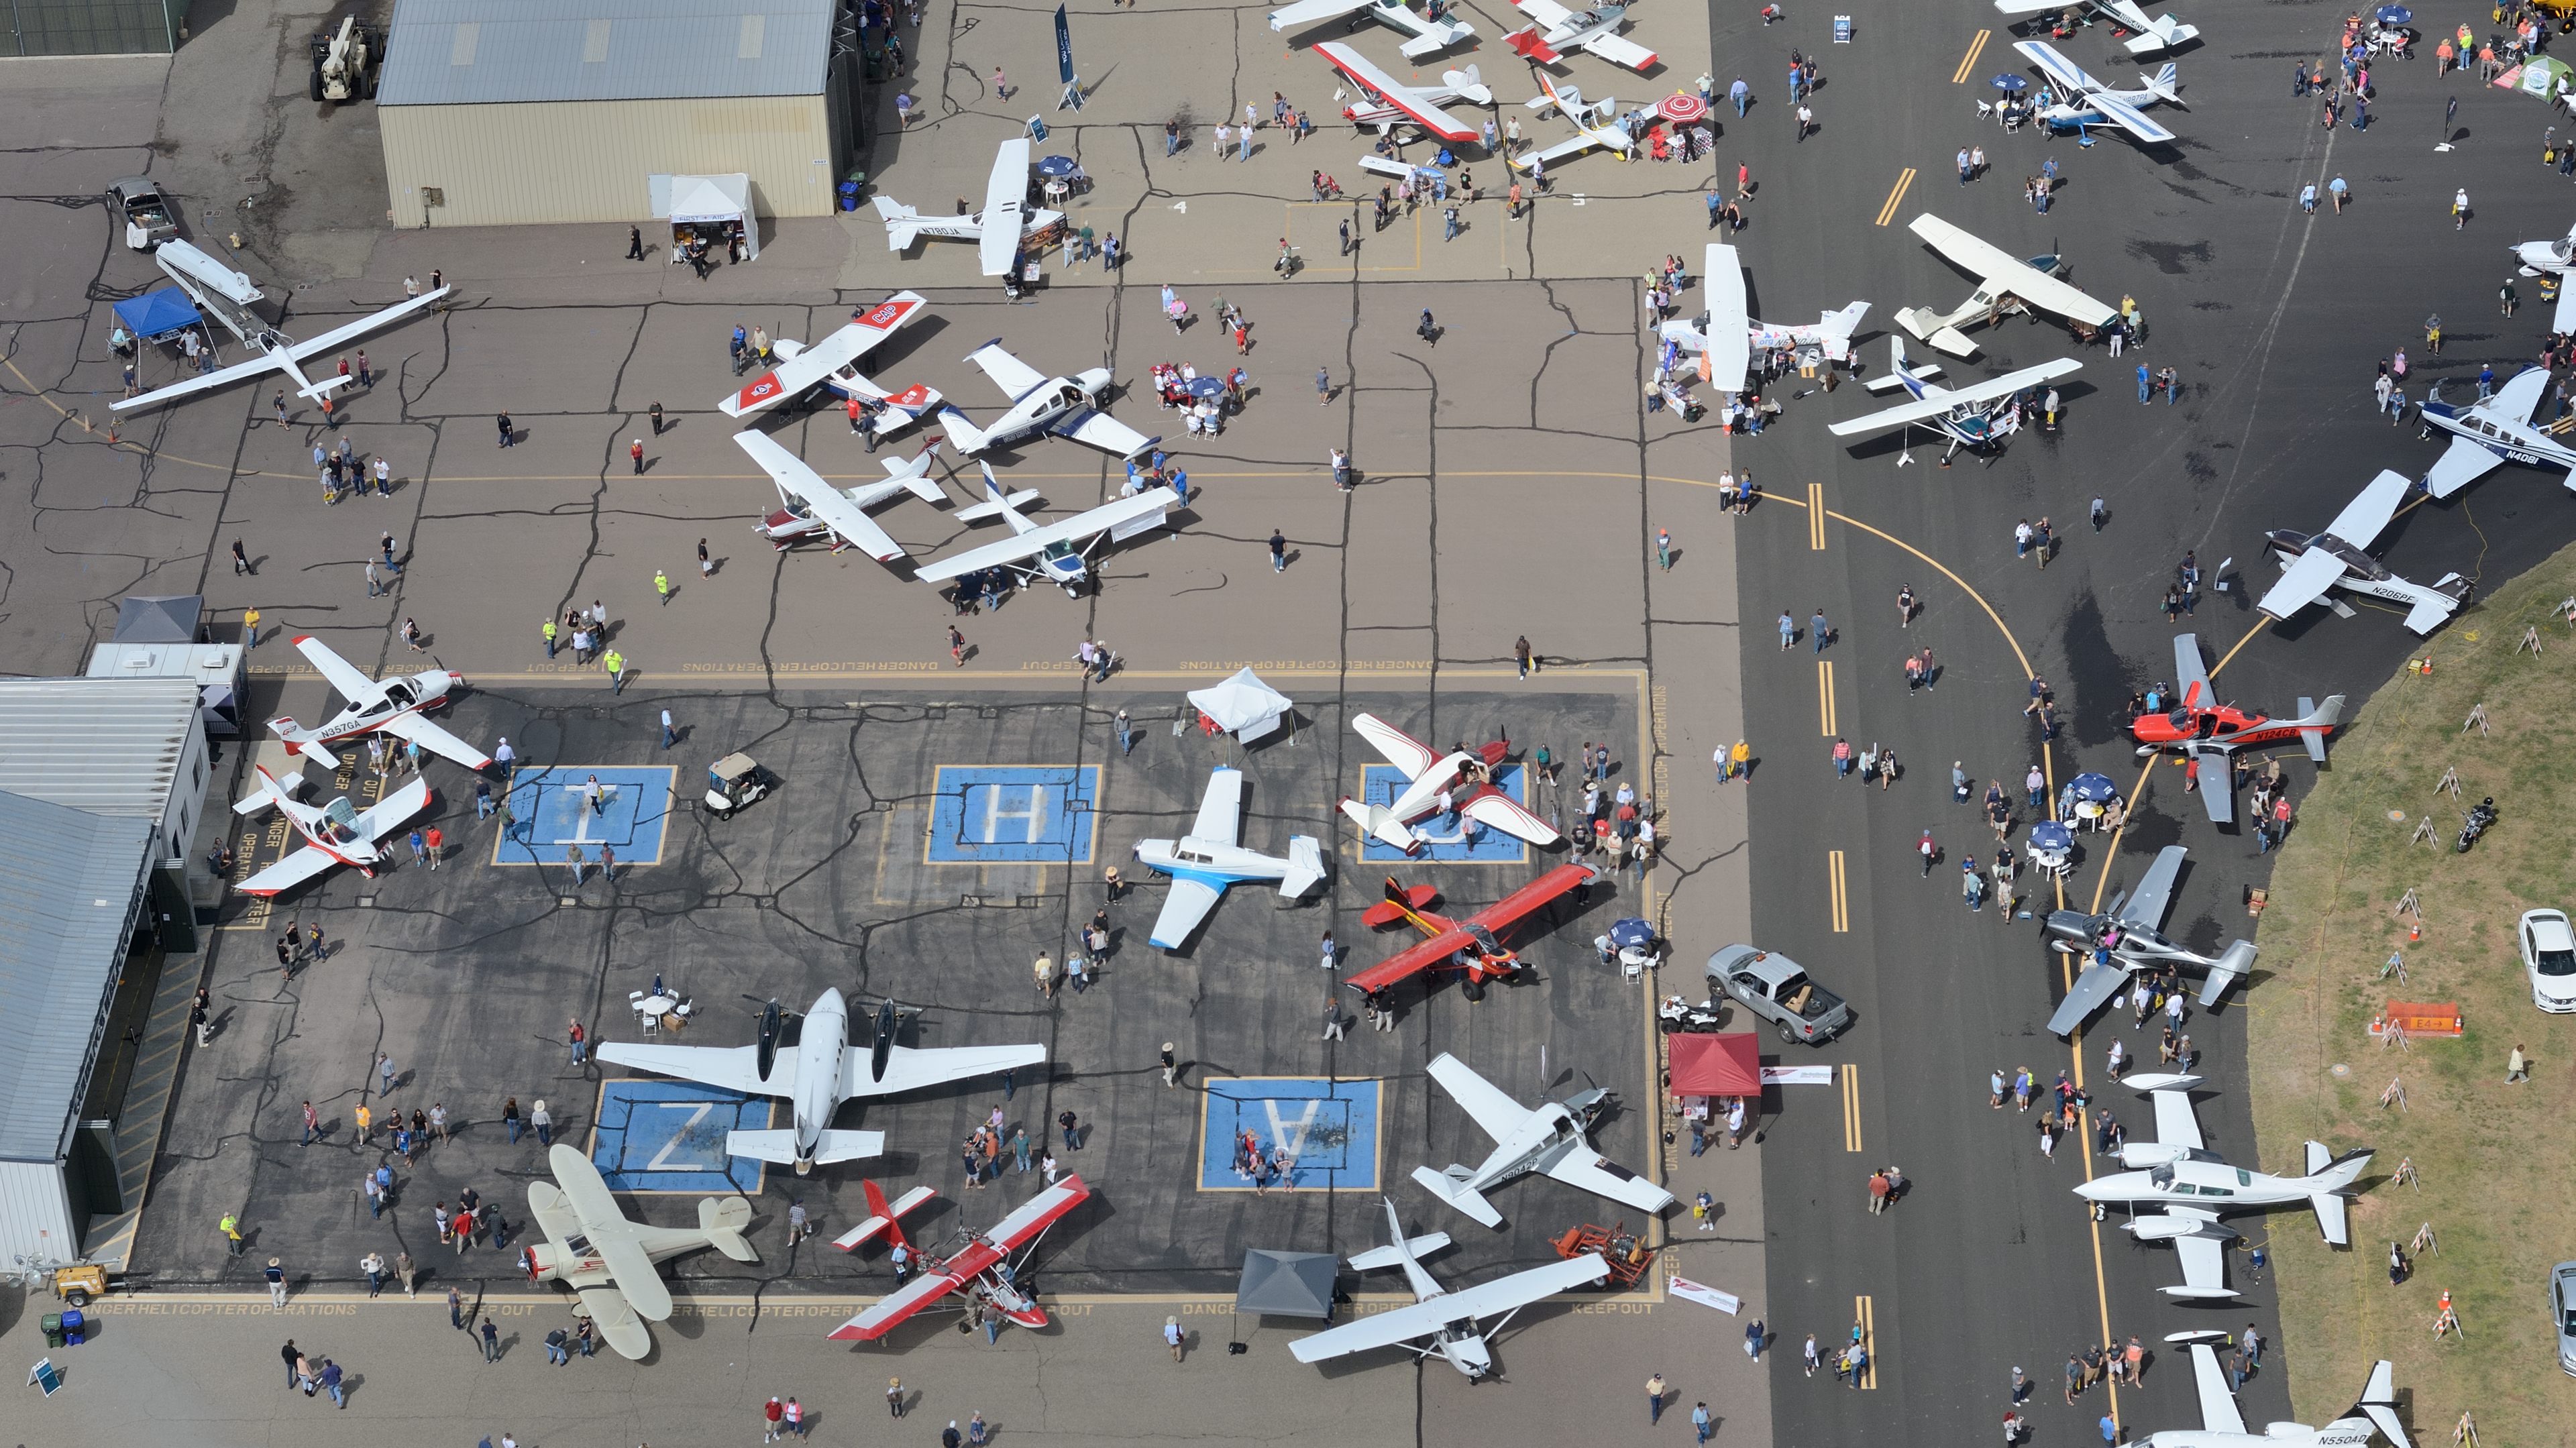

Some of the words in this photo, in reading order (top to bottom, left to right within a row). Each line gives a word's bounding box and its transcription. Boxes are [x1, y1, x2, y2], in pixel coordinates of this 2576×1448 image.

[2112, 12, 2146, 34] N8540X
[1173, 201, 1187, 214] 4
[872, 305, 896, 323] CAP
[2373, 587, 2415, 602] N206PF
[527, 663, 555, 672] OUT
[558, 663, 598, 672] KEEP
[683, 663, 778, 671] OPERATIONS
[781, 663, 874, 671] HELICOPTER
[878, 663, 938, 671] DANGER
[1020, 662, 1050, 671] OUT
[1179, 661, 1268, 670] OPERATIONS
[1653, 685, 1667, 740] OPERATIONS
[322, 721, 362, 739] N357GA
[2255, 728, 2297, 740] N124CB
[334, 754, 357, 790] DANGER
[362, 780, 378, 799] OUT
[984, 784, 1043, 844] H
[1657, 891, 1672, 915] OUT
[2417, 1019, 2431, 1029] E4
[647, 1103, 712, 1171] Z
[1501, 1158, 1538, 1182] N9042P
[140, 1303, 249, 1316] HELICOPTER
[250, 1304, 357, 1316] OPERATIONS
[502, 1304, 535, 1316] OUT
[695, 1305, 804, 1317] HELICOPTER
[1058, 1305, 1095, 1317] OUT
[1183, 1303, 1238, 1315] DANGE
[1572, 1303, 1617, 1315] KEEP
[1621, 1303, 1653, 1315] OUT
[2319, 1434, 2367, 1445] N550AD
